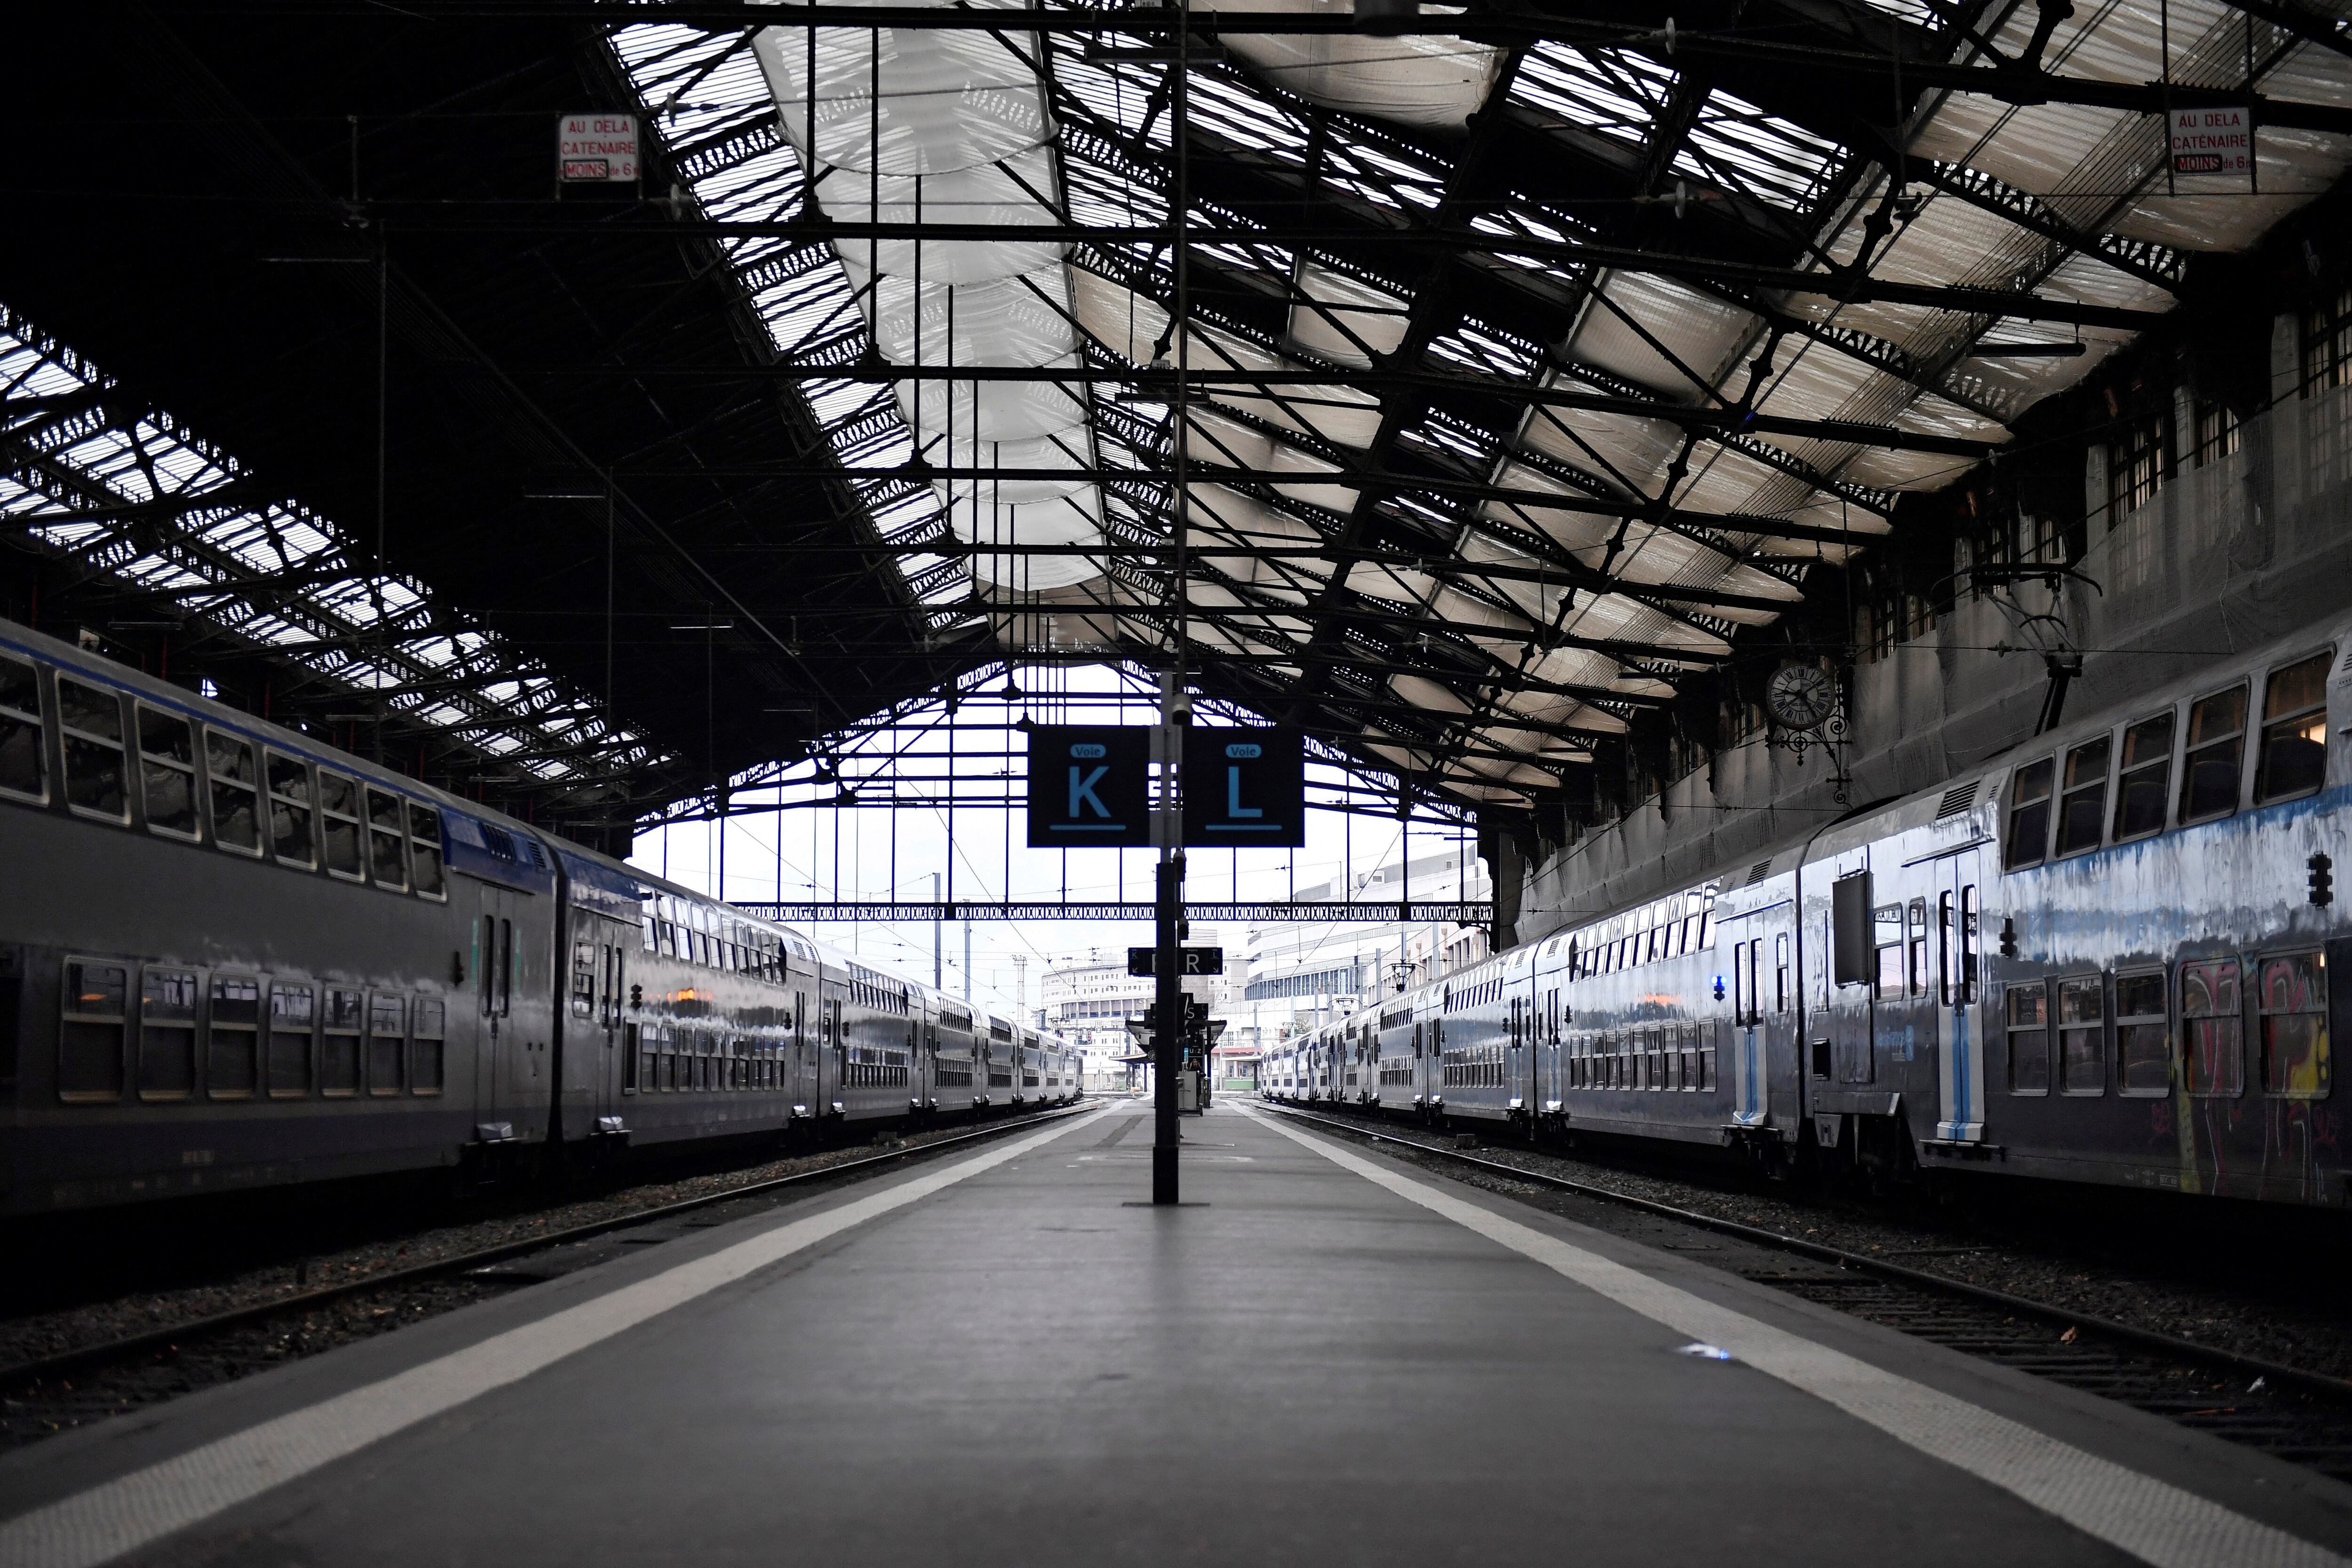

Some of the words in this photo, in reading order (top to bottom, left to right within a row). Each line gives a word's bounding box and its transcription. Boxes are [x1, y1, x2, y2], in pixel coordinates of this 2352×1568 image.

[2178, 114, 2197, 127] AU
[2205, 113, 2241, 127] DELA
[568, 121, 586, 134] AU
[566, 163, 606, 177] MOINS
[610, 166, 620, 176] de
[2178, 157, 2220, 170] MOINS
[2223, 158, 2233, 169] de
[1075, 746, 1101, 757] Voie
[1231, 746, 1256, 757] Voie
[1069, 766, 1112, 818] K
[1228, 766, 1263, 818] L
[1186, 954, 1200, 973] R
[1187, 1007, 1195, 1019] S
